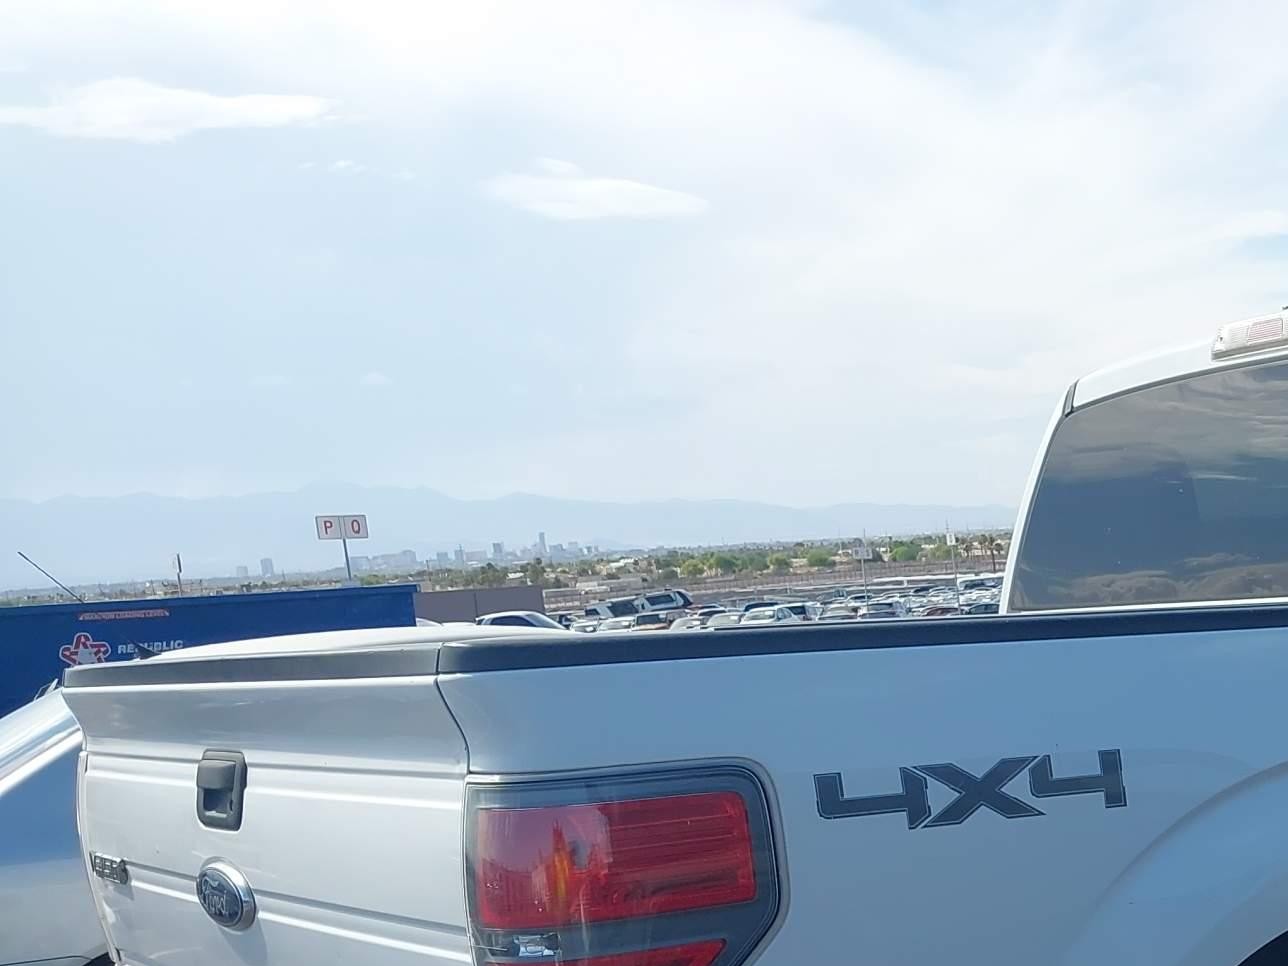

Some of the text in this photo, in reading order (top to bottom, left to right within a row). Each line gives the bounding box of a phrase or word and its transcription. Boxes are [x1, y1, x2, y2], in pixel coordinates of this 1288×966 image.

[323, 520, 333, 535] P
[351, 519, 361, 535] Q
[201, 877, 230, 917] Ford
